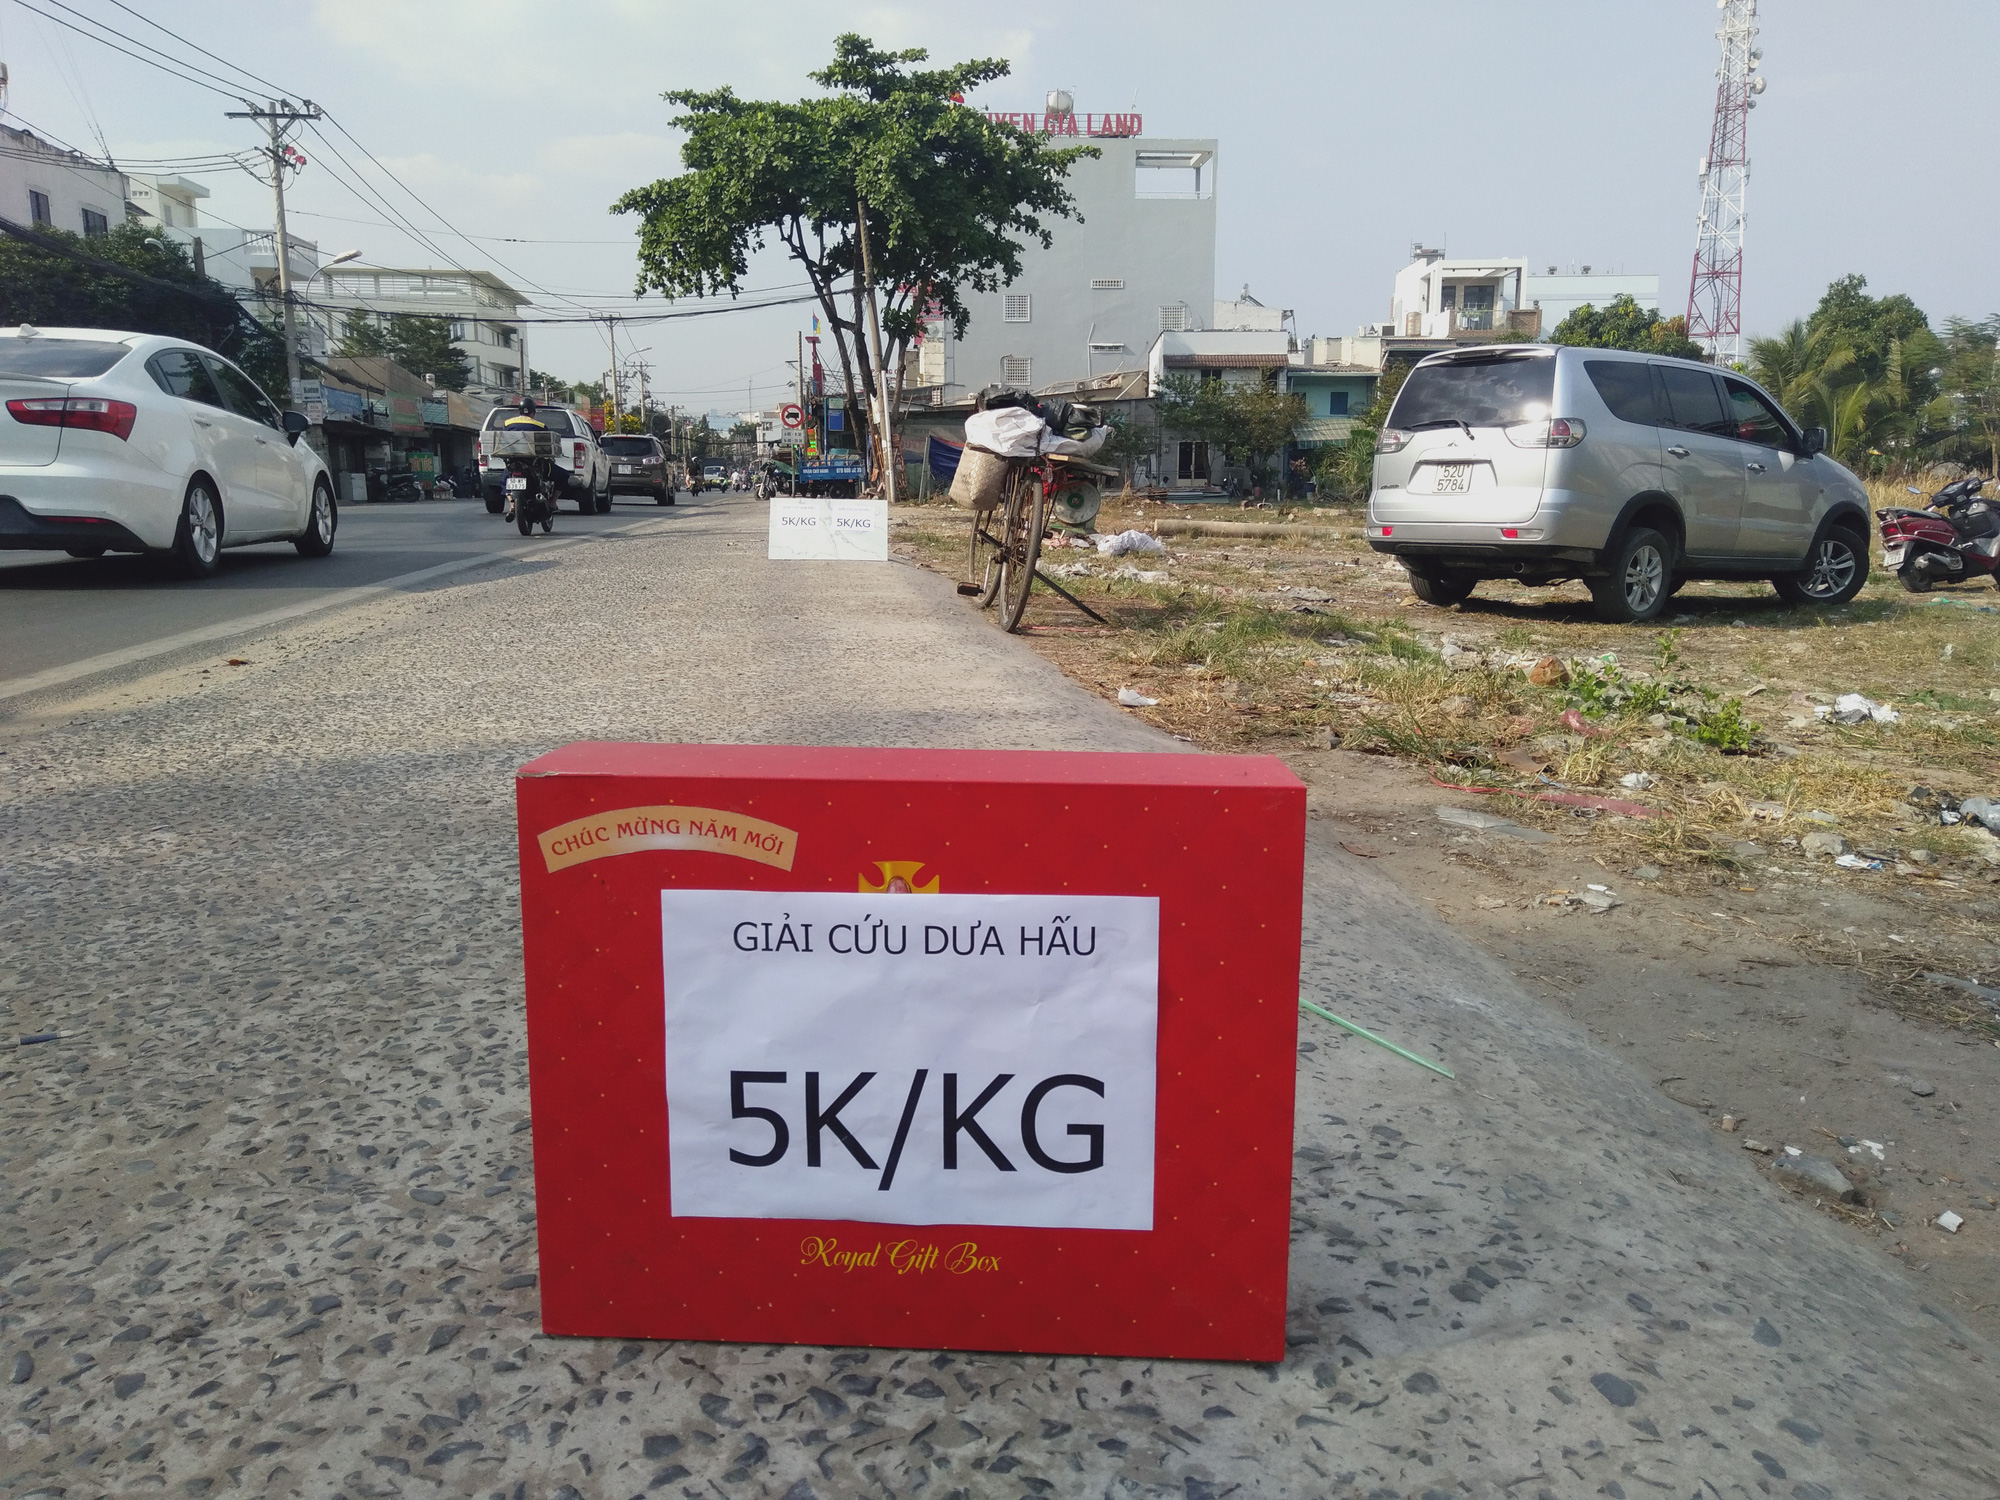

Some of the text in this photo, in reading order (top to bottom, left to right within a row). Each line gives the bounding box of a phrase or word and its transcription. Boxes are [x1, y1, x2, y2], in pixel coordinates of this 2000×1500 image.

[1043, 112, 1079, 136] GIA
[1087, 113, 1143, 136] LAND
[1437, 479, 1464, 491] 5784
[782, 516, 816, 527] 5K/KG
[836, 518, 870, 528] 5K/KG
[551, 817, 784, 856] CHÚC MỪNG NĂM MỚI
[733, 913, 1096, 956] GIẢI CỨU DƯA HẤU
[729, 1069, 1105, 1191] 5K/KG
[801, 1236, 1001, 1274] Royal Gift Box
